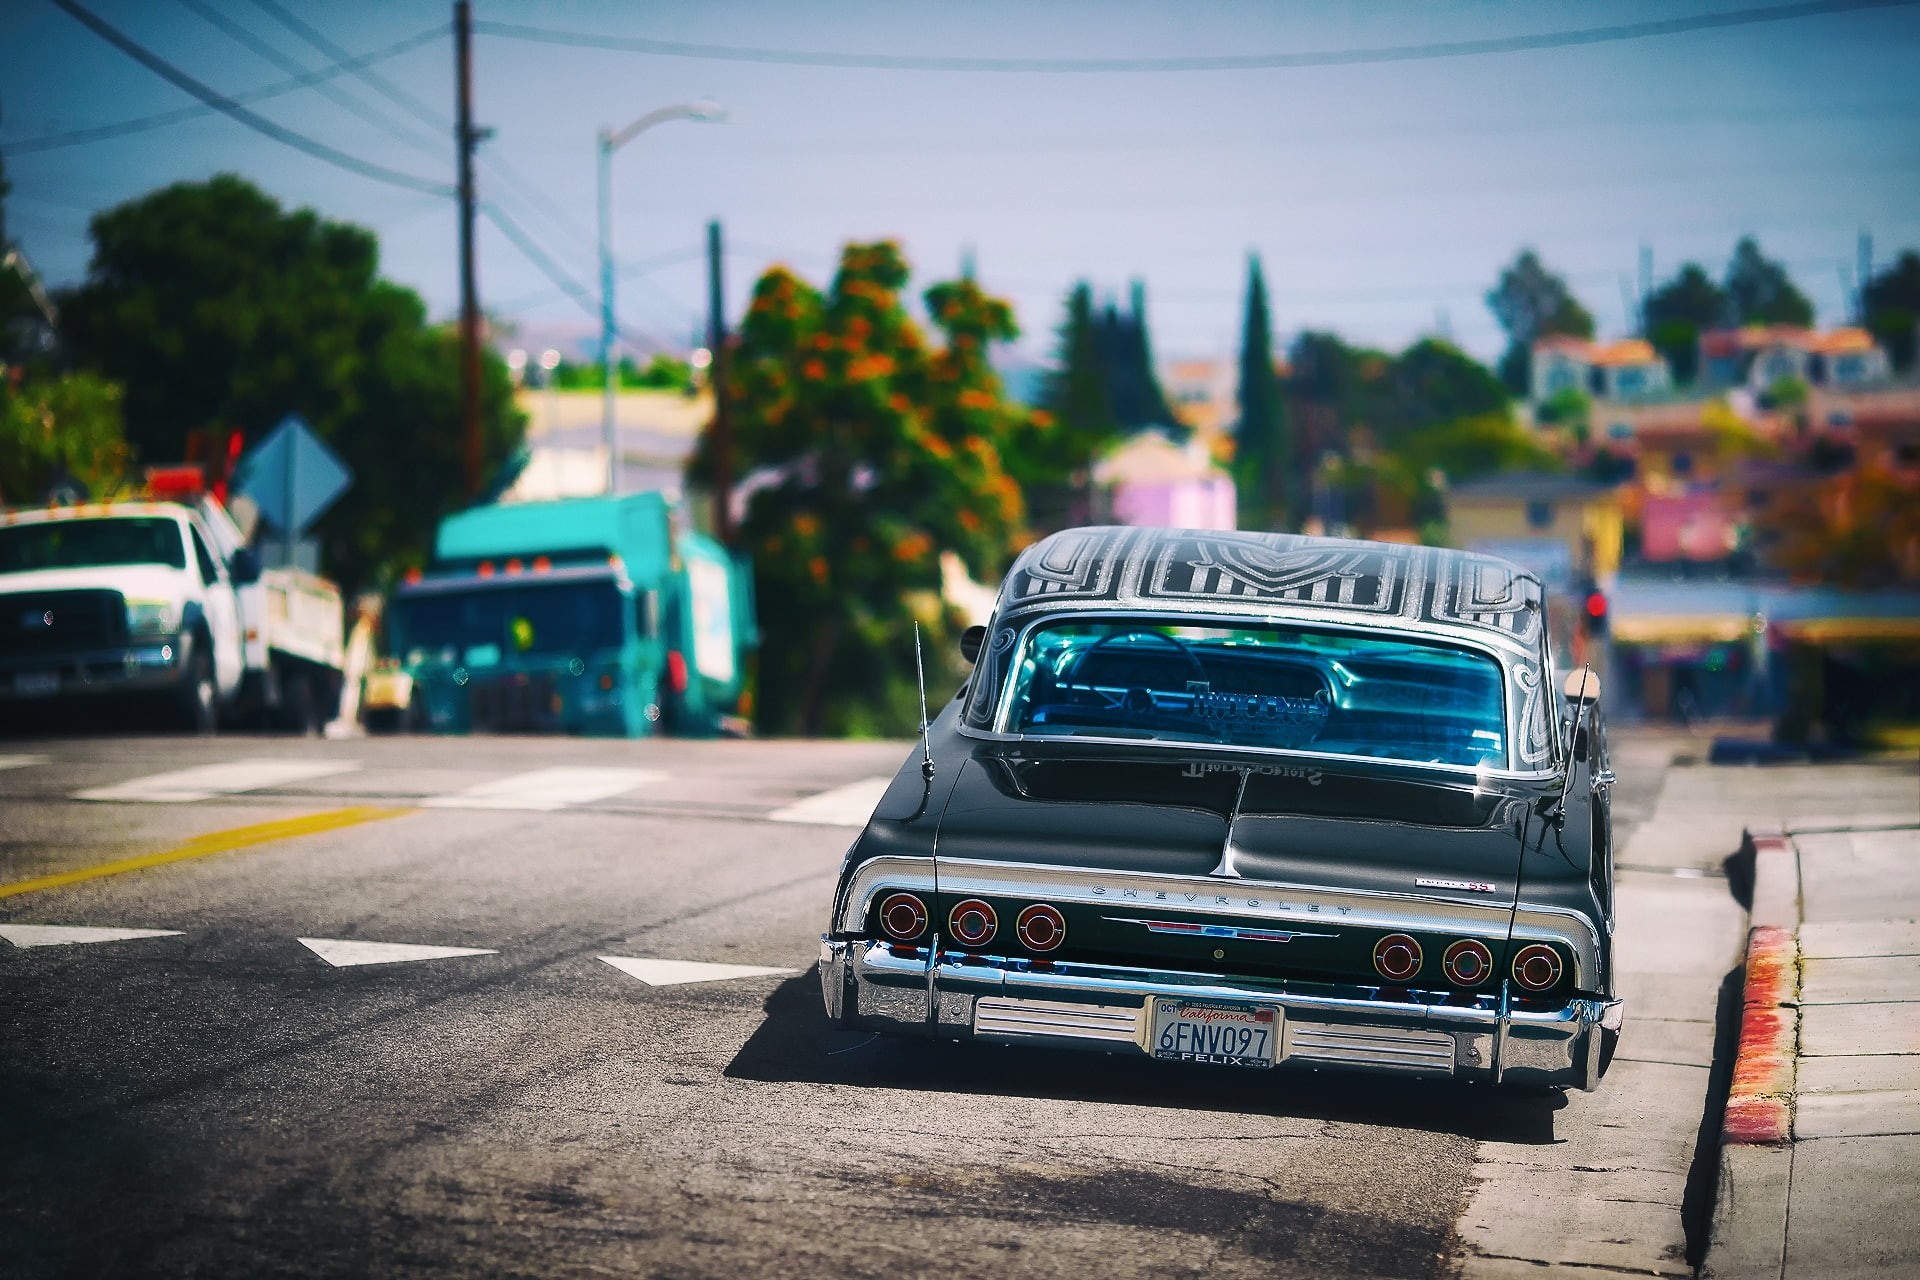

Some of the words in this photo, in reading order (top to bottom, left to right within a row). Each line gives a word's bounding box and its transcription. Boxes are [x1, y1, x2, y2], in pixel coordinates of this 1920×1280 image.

[1468, 881, 1489, 892] SS
[1091, 885, 1352, 915] CHEVROLET
[1160, 1003, 1177, 1013] OCT
[1179, 1006, 1256, 1024] California
[1161, 1022, 1268, 1057] 6FNV097
[1181, 1052, 1243, 1066] FELIX
